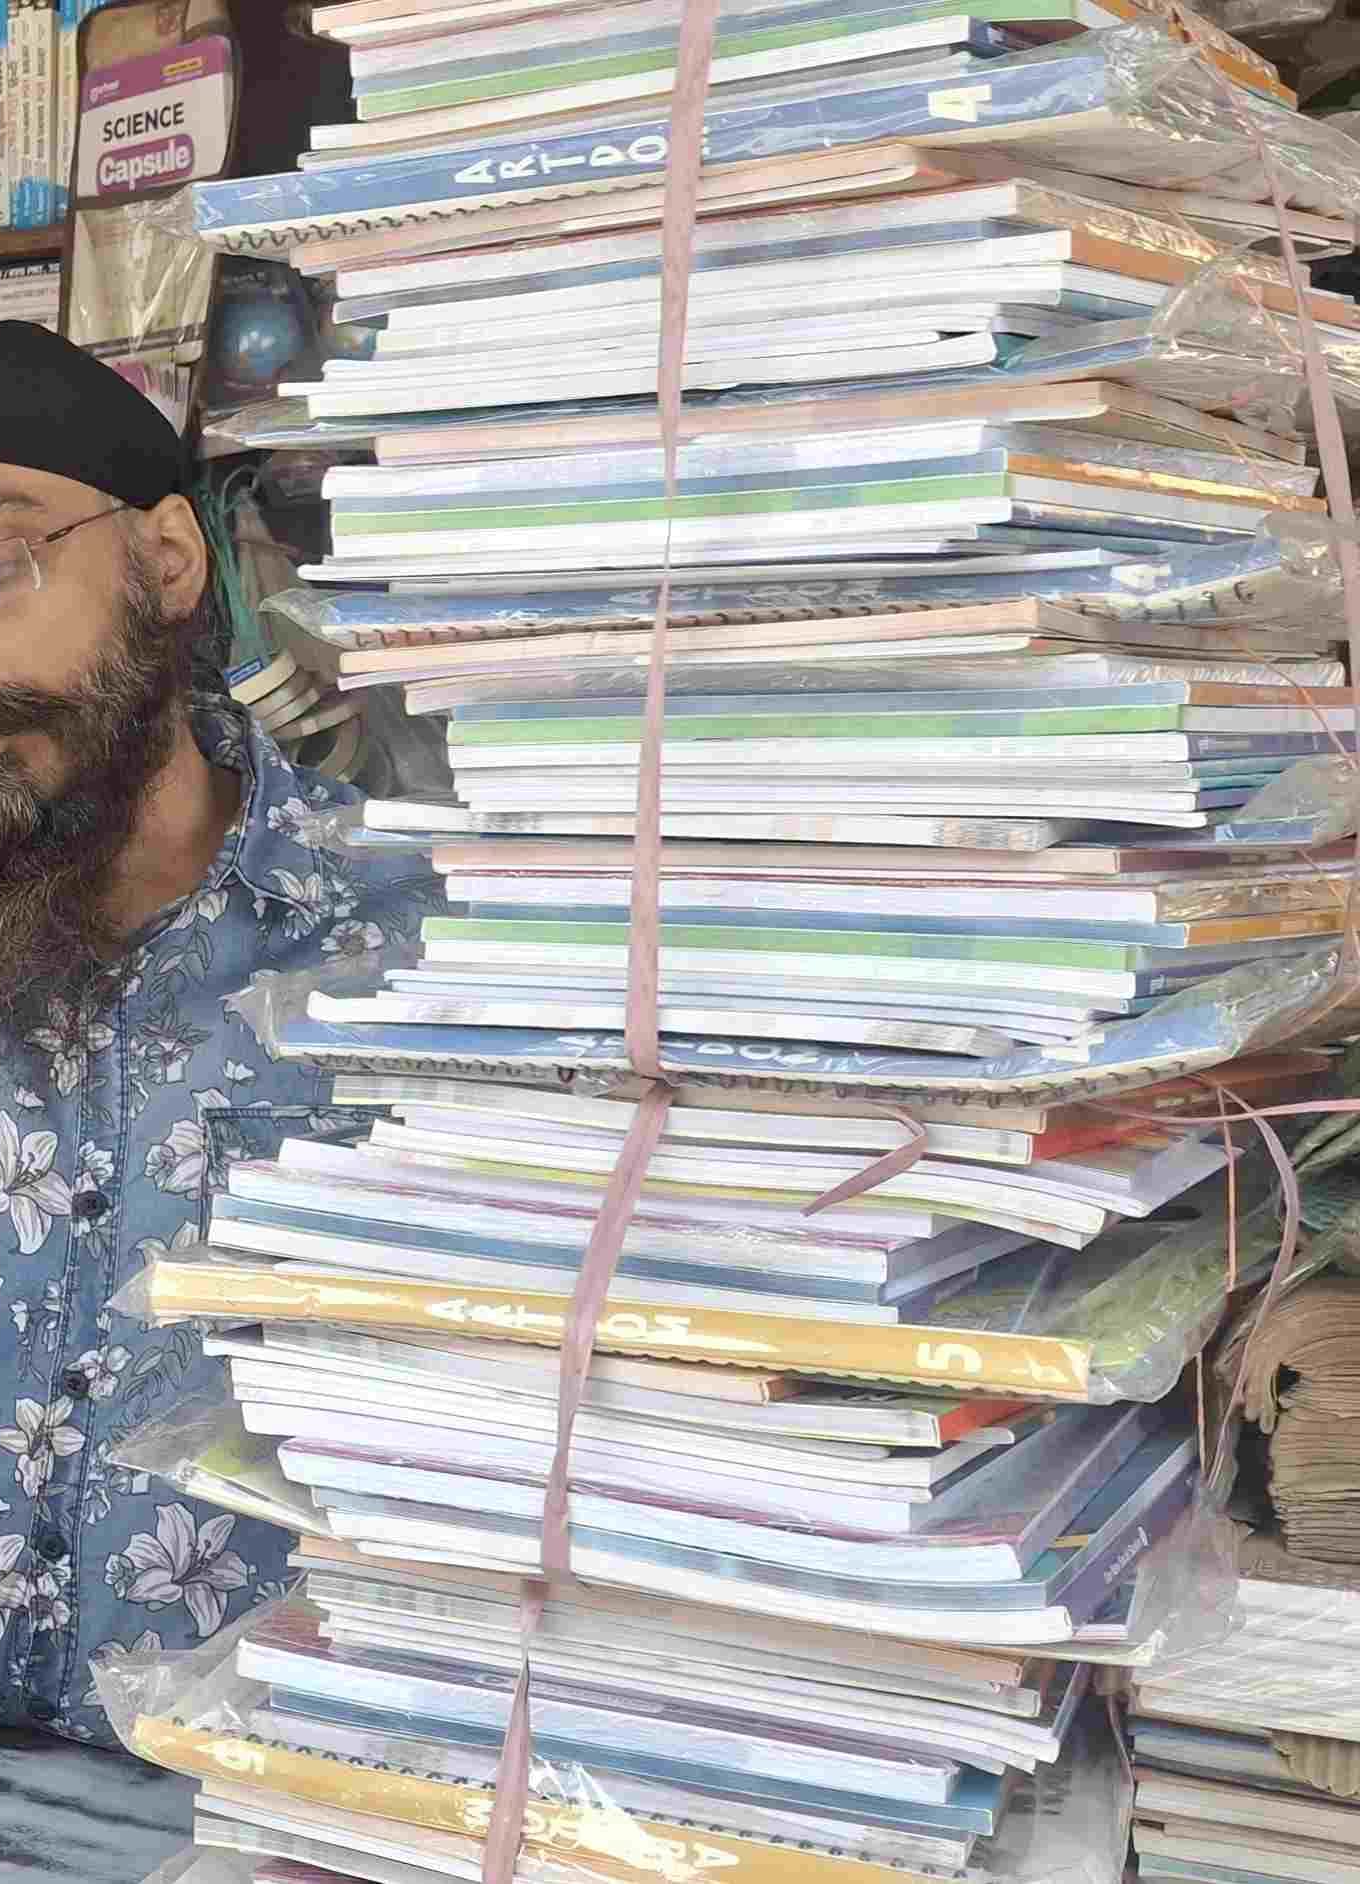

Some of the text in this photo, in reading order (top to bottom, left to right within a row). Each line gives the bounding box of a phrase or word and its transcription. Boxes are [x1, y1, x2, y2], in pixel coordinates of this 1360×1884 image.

[103, 101, 185, 143] SCIENCE
[99, 139, 190, 191] Capsule
[455, 128, 710, 185] ARTDO
[917, 1342, 983, 1375] 5
